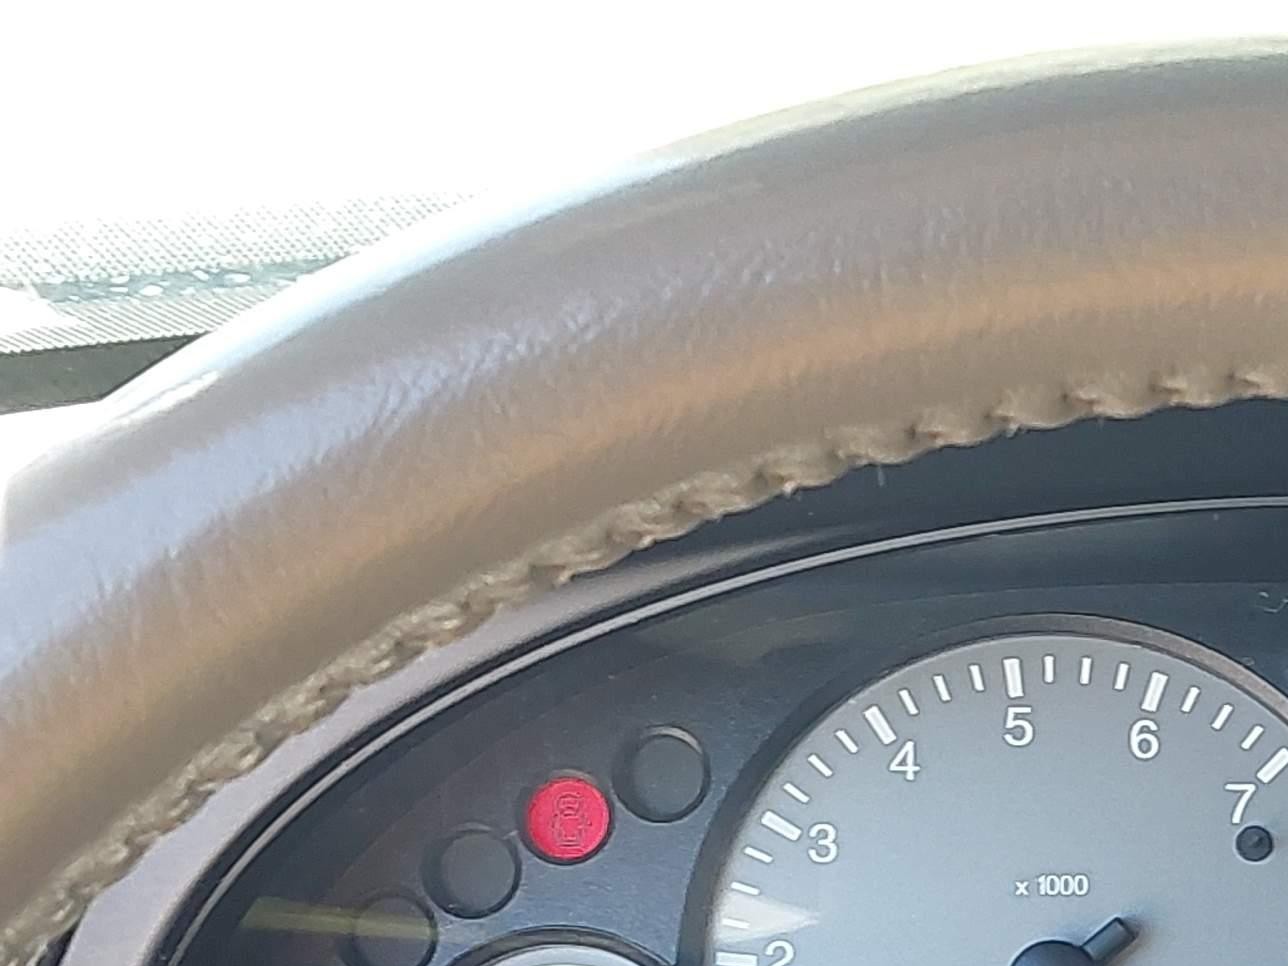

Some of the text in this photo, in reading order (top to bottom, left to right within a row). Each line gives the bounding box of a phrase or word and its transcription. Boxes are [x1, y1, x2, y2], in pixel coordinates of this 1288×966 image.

[1003, 706, 1035, 747] 5
[1128, 719, 1160, 760] 6
[888, 741, 921, 781] 4
[1224, 782, 1257, 824] 7
[807, 823, 839, 864] 3
[1014, 875, 1089, 896] x 1000
